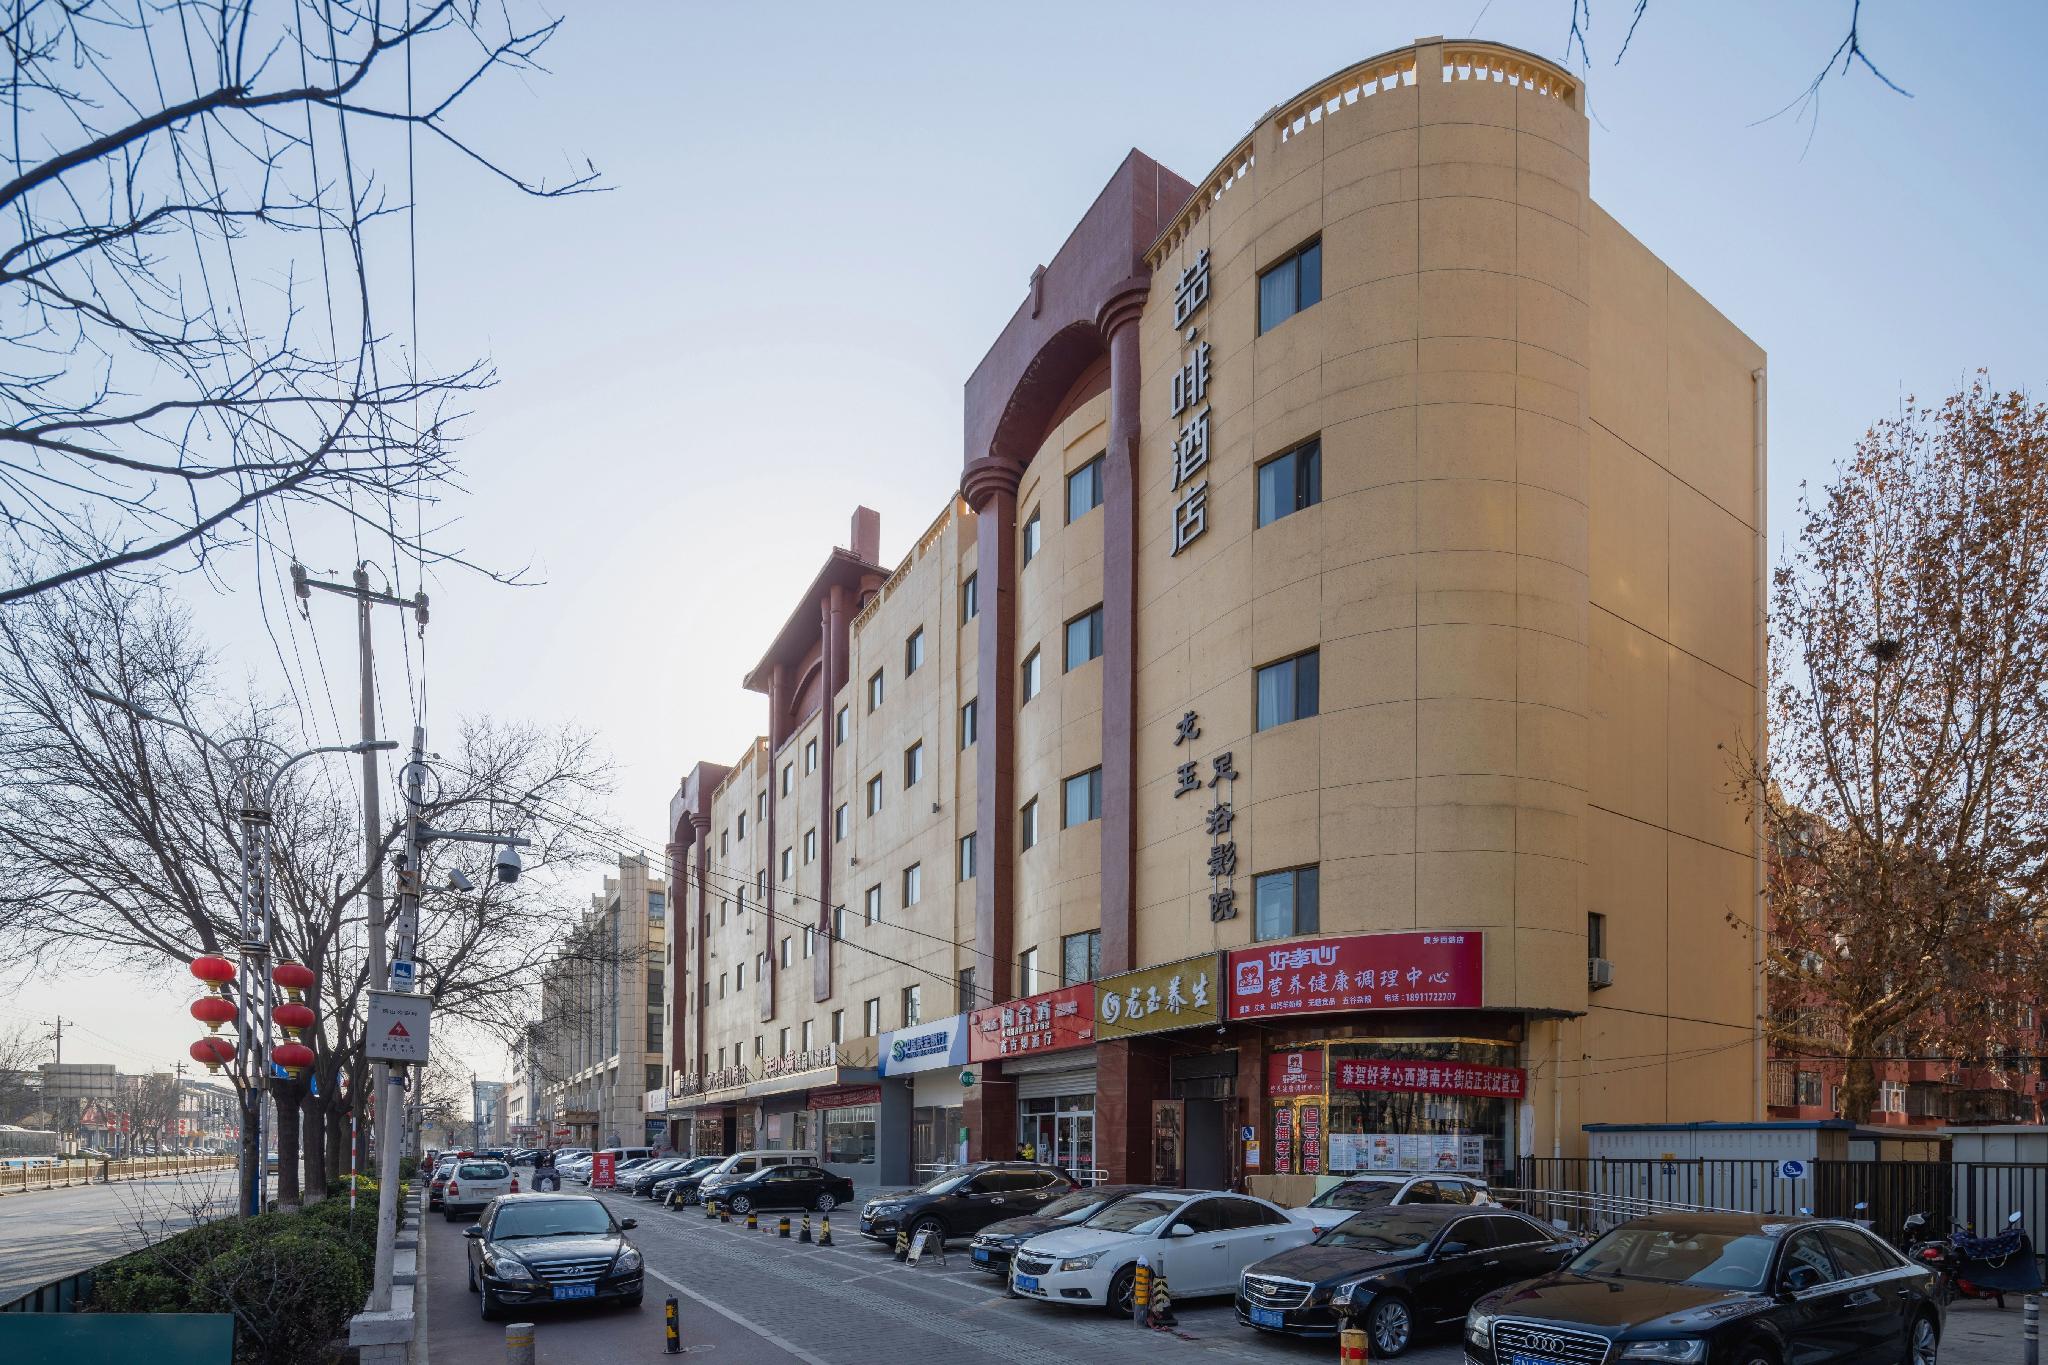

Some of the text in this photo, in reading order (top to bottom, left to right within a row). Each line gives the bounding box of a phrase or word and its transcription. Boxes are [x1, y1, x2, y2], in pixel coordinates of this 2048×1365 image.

[1206, 752, 1238, 923] 足浴影院
[1267, 945, 1341, 972] 好孝心
[1267, 967, 1450, 998] 营养健康调理中心
[1124, 972, 1210, 1020] 龙玉养生
[1342, 1064, 1521, 1094] 恭贺好孝心西潞南大街店正式试营业
[1275, 1108, 1291, 1175] 传播孝道
[1303, 1107, 1320, 1175] 倡导健康
